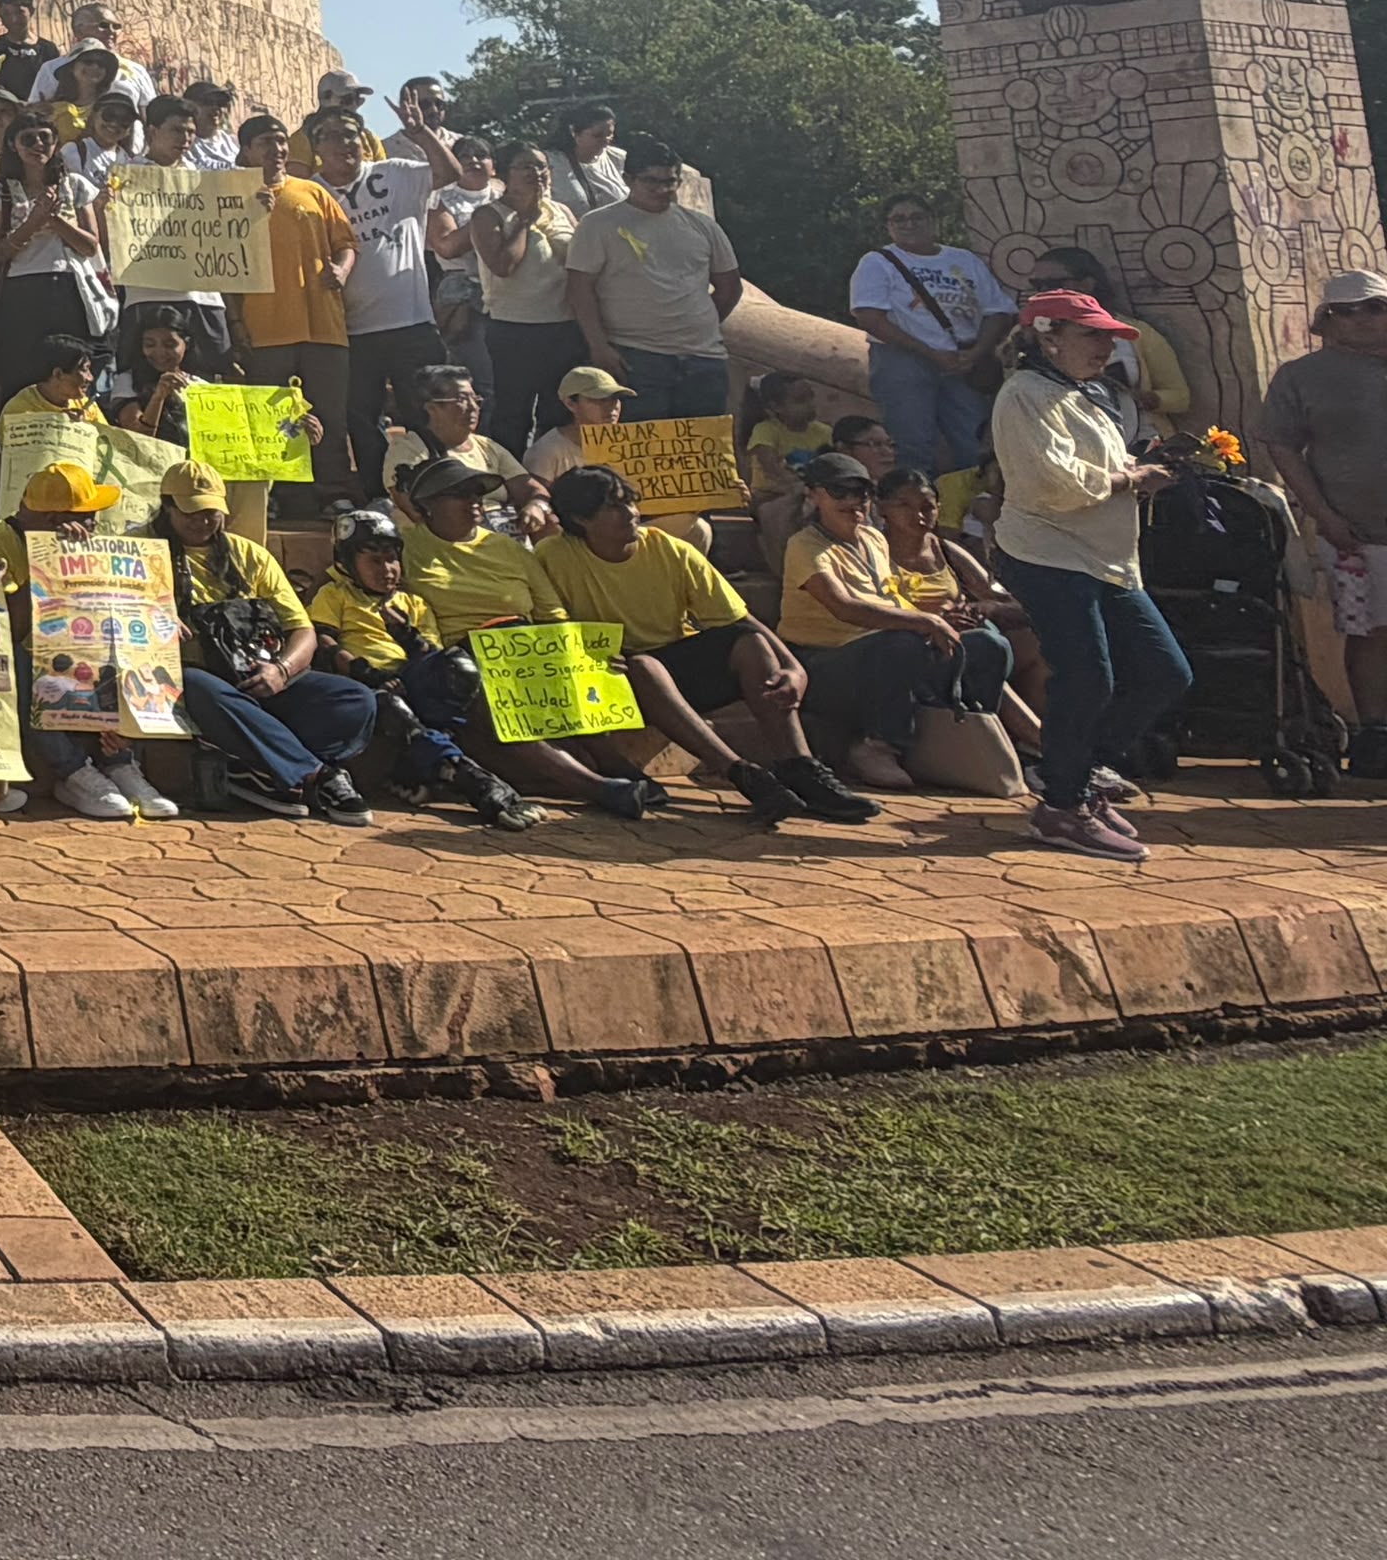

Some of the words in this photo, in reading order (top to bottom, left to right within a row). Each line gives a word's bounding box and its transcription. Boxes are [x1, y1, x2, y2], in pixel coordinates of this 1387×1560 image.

[121, 179, 205, 211] Caminamos
[216, 194, 244, 217] para
[336, 173, 389, 210] YC
[130, 214, 187, 238] recordar
[191, 219, 222, 247] que
[228, 217, 250, 239] no
[128, 243, 186, 262] estamos
[186, 392, 217, 412] TU
[582, 422, 660, 446] HABLAR
[675, 419, 702, 438] DE
[608, 437, 716, 463] SUICIDIO
[624, 461, 646, 476] LO
[654, 453, 727, 473] FOMENTA
[637, 469, 736, 498] PREVIENE
[59, 539, 77, 554] TU
[82, 538, 141, 557] HISTORIA
[59, 554, 147, 580] IMPORTA
[487, 667, 511, 679] no
[515, 666, 536, 679] es
